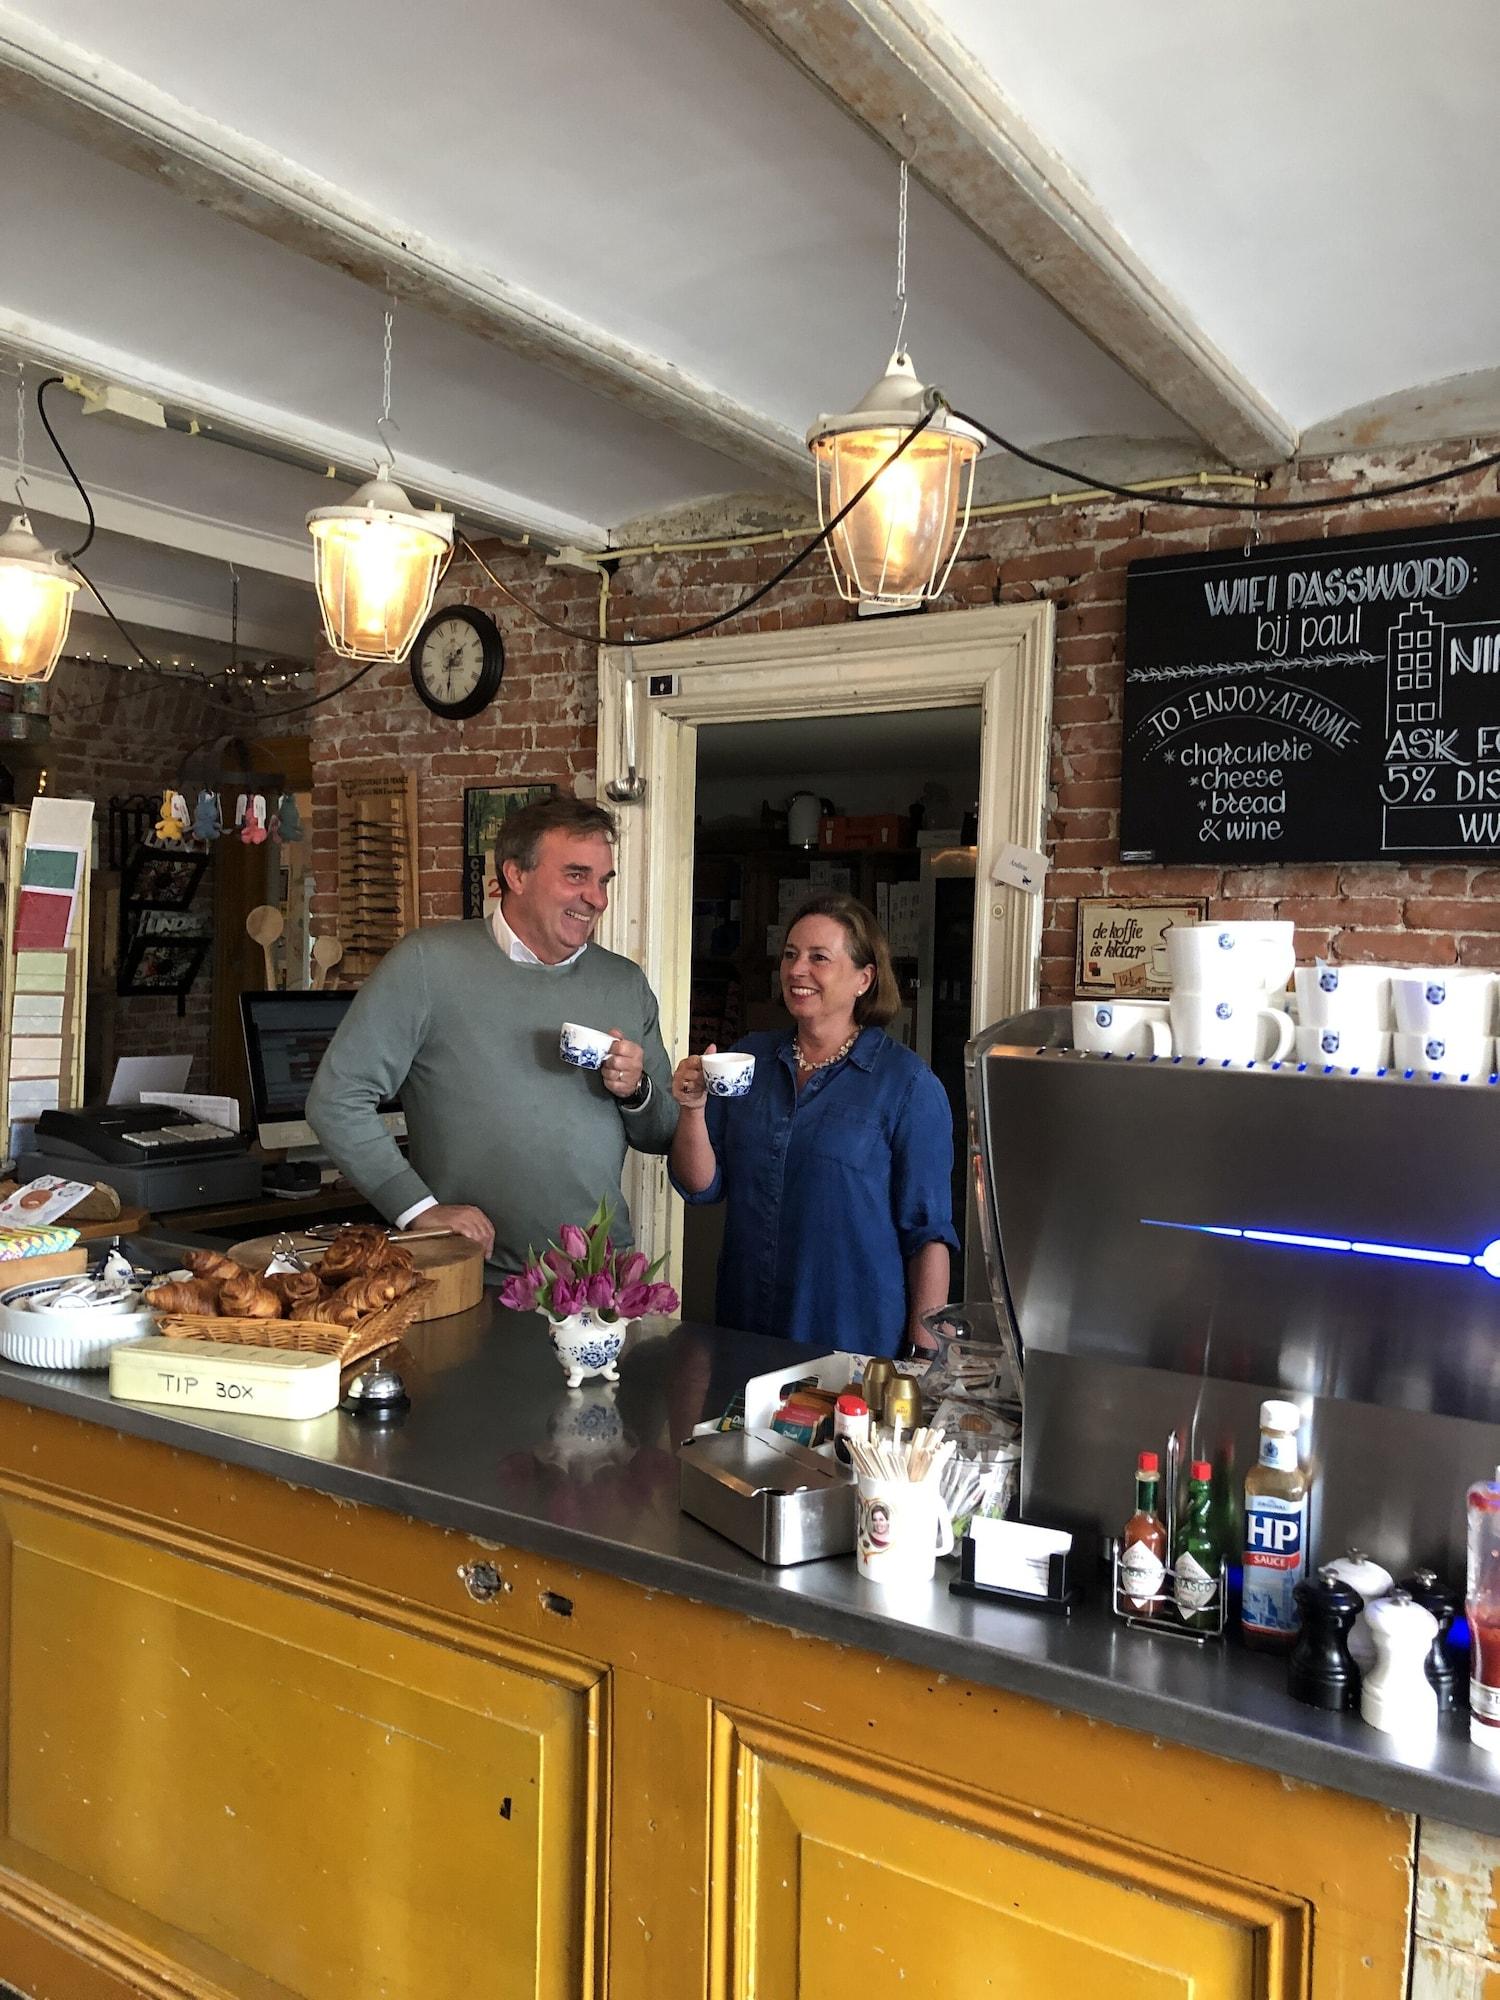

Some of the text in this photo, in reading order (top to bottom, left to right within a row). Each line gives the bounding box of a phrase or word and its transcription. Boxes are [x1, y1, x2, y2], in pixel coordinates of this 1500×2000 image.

[1204, 574, 1277, 616] WIFI
[1256, 605, 1361, 657] bij paul
[1450, 633, 1500, 675] NI
[1385, 726, 1500, 766] ASK F
[1201, 766, 1283, 789] cheese
[1379, 766, 1436, 803] 5%
[1199, 816, 1284, 841] & wine
[1093, 918, 1143, 945] de koffie
[1090, 941, 1146, 959] is klaar
[158, 1372, 199, 1395] TIP
[1248, 1513, 1299, 1551] HP
[1253, 1554, 1287, 1568] SAUCE
